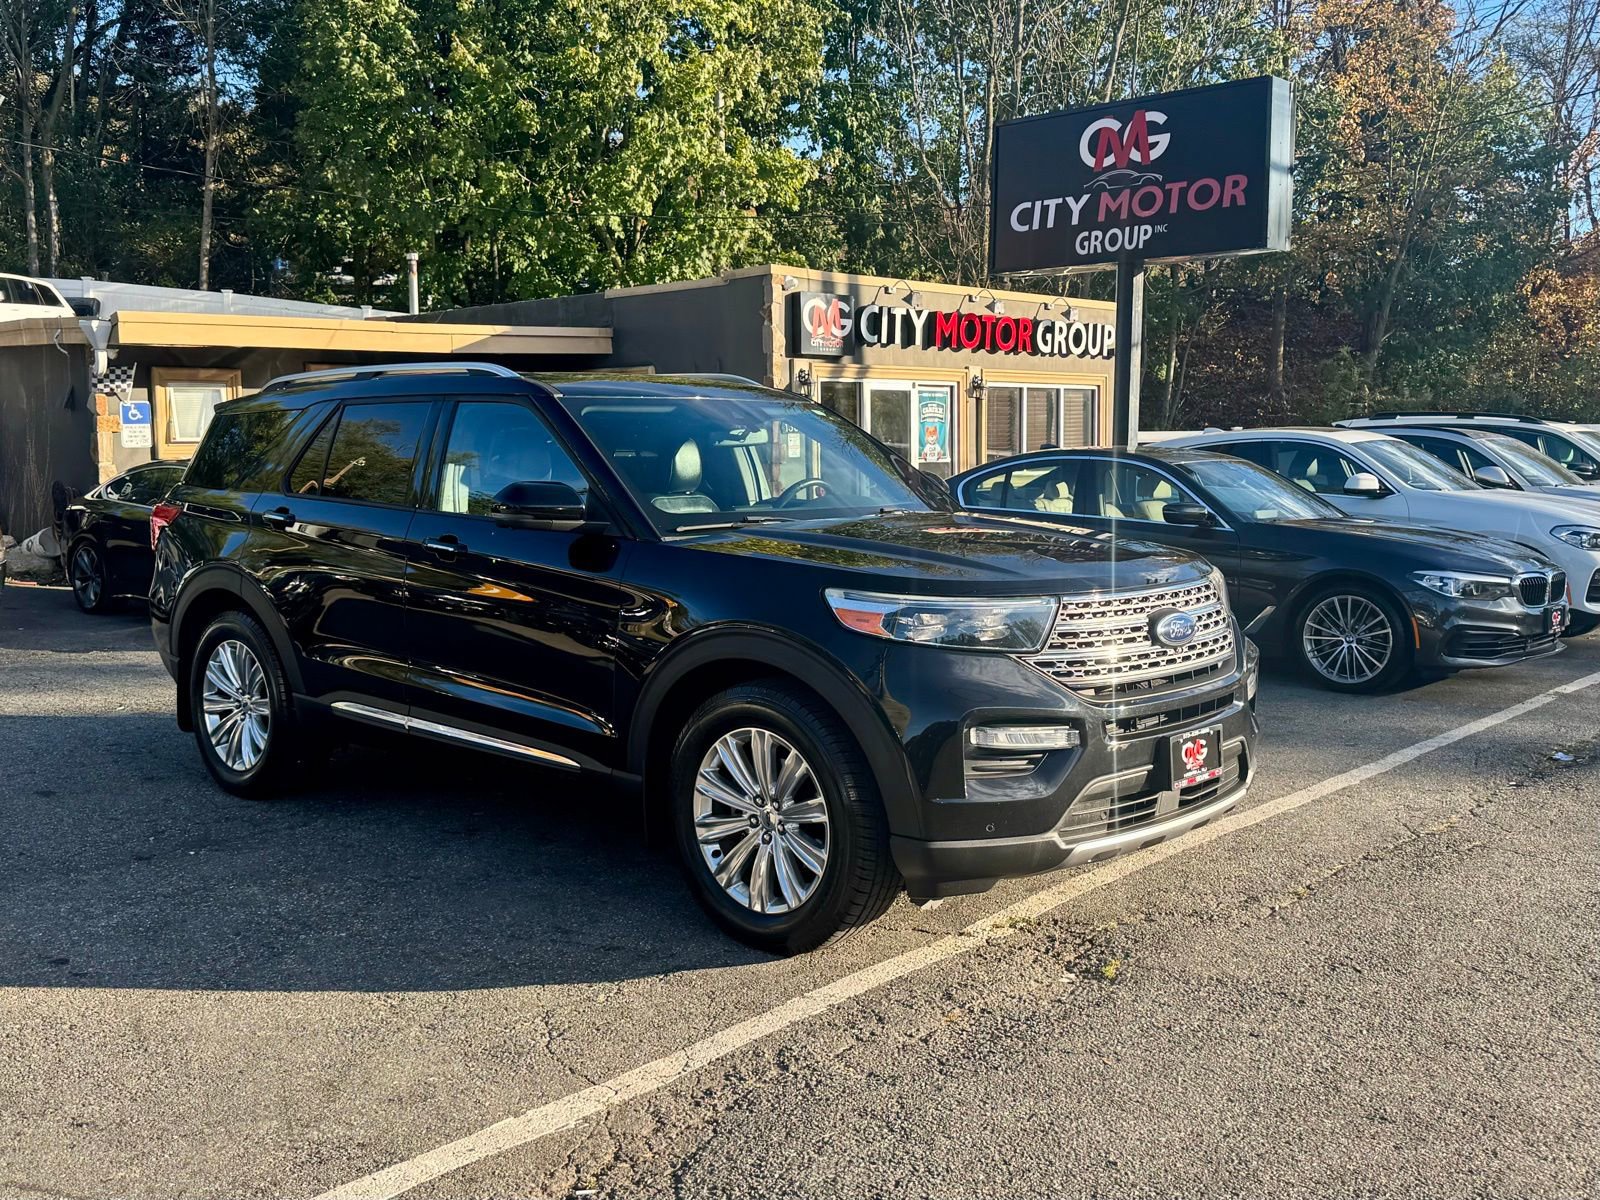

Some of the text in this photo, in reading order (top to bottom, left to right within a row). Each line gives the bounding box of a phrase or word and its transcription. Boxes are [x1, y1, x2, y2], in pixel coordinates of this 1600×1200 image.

[1010, 174, 1248, 232] CITY MOTOR
[1075, 223, 1168, 255] GROUP INC
[860, 304, 1115, 357] CITY MOTOR GROUP
[1170, 619, 1192, 638] Ford
